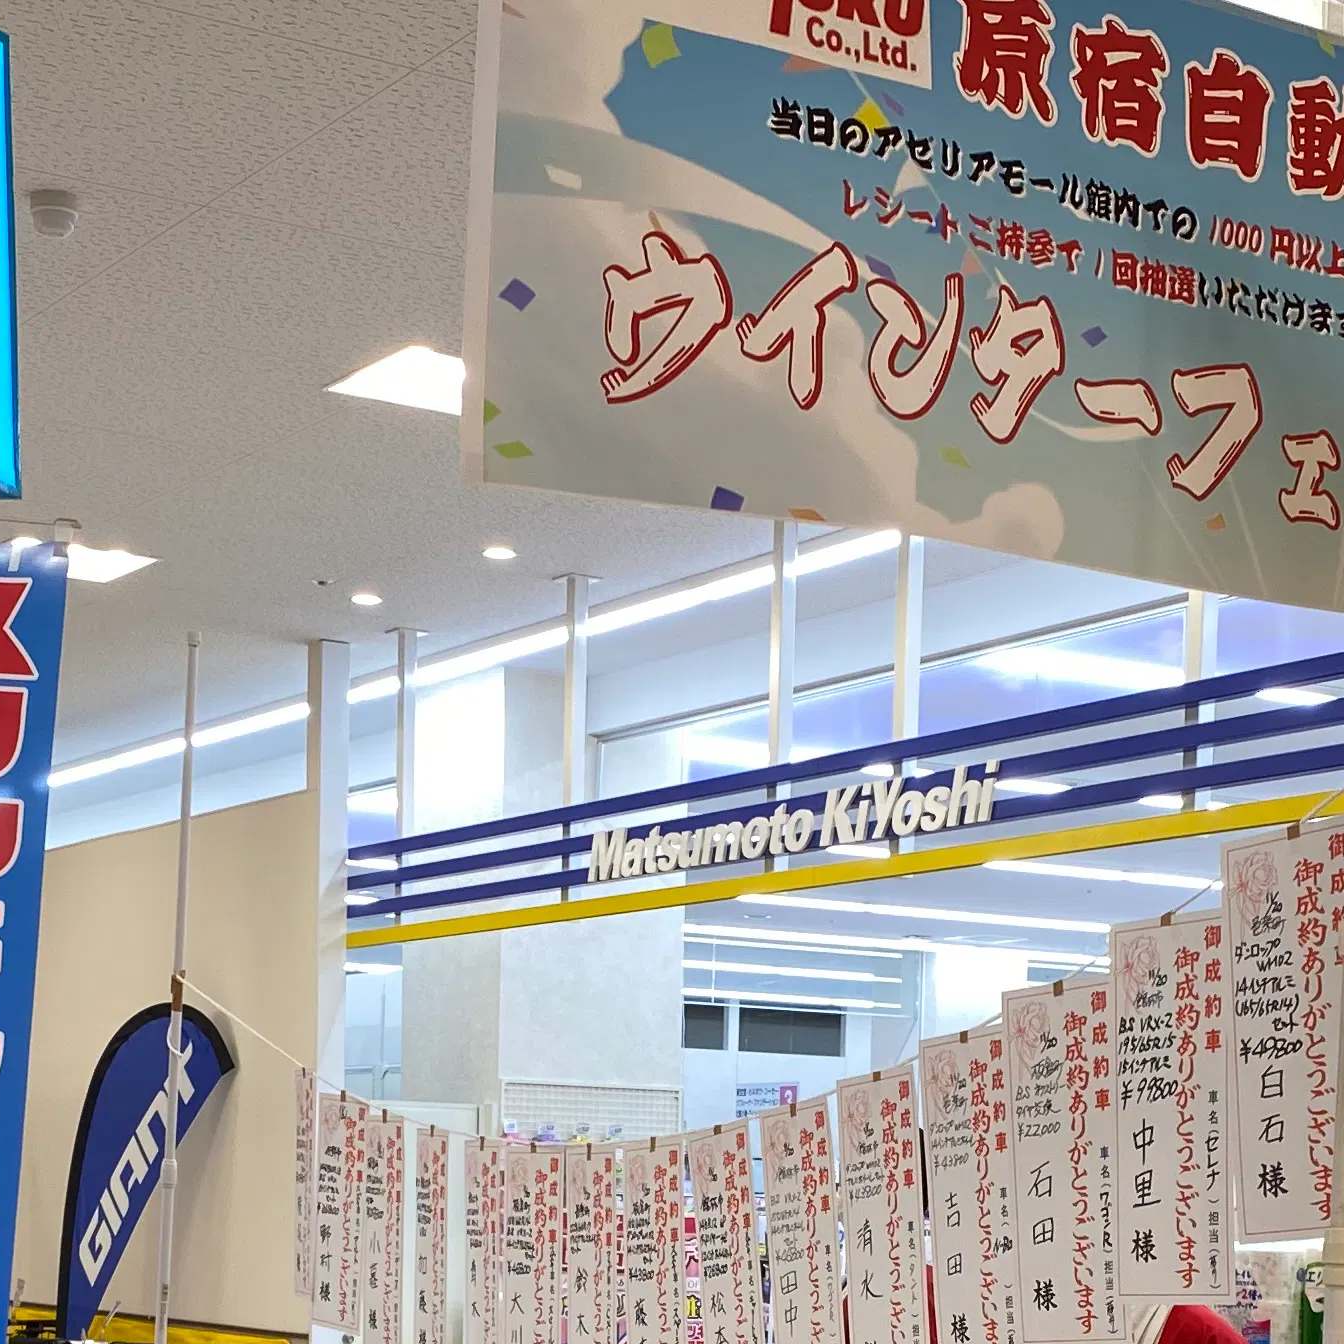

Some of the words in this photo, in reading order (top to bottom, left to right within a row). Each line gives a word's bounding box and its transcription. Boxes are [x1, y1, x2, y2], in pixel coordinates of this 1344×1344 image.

[806, 15, 918, 72] Co.,Ltd.
[588, 803, 814, 884] Matsumoto
[819, 759, 1001, 855] KiYoshi
[1089, 990, 1112, 1112] 御成約車
[1204, 925, 1224, 1054] 御成約車
[76, 1040, 197, 1288] GIANT
[1061, 1010, 1096, 1336] 御成約ありがとうございます
[1172, 945, 1202, 1290] 御成約ありがとうございます
